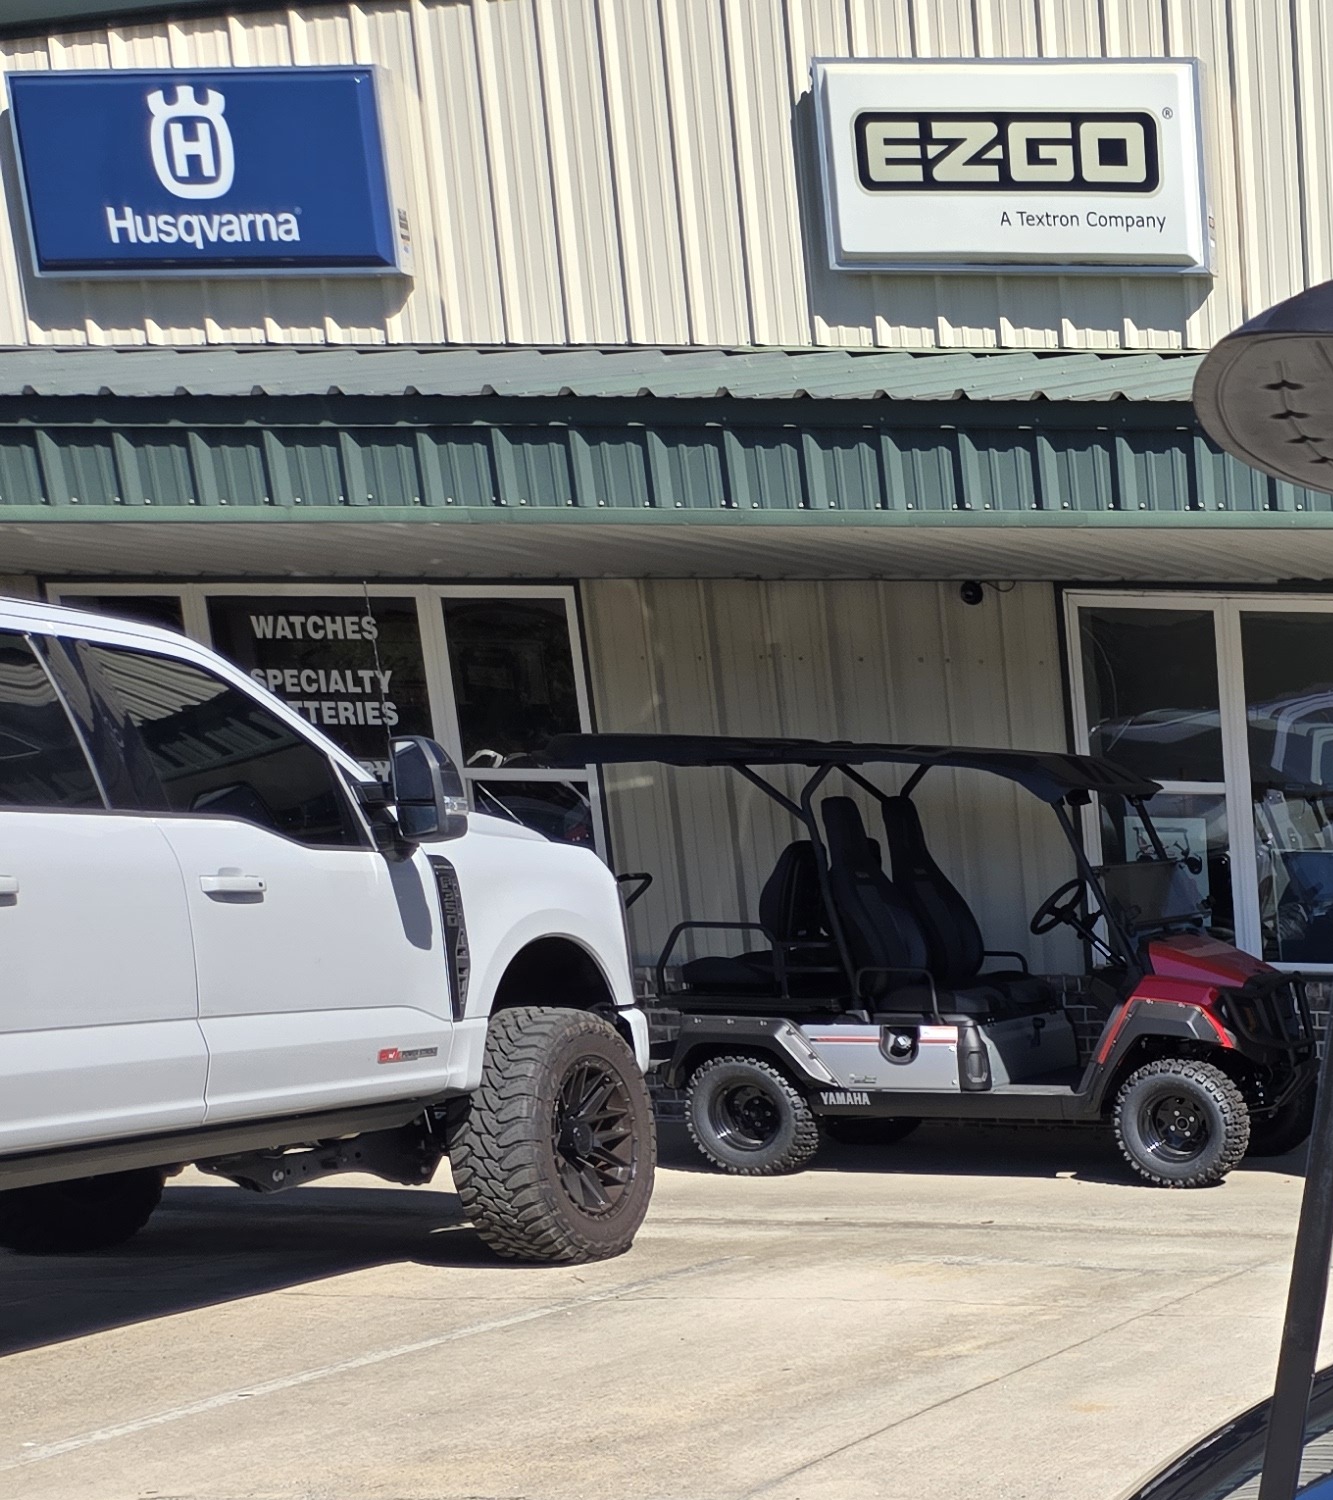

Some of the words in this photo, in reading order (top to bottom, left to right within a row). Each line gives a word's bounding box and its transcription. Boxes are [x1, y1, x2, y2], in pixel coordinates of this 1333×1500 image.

[864, 121, 1147, 182] EZGO
[105, 206, 301, 250] Husqvarna
[1000, 211, 1012, 227] A
[1016, 211, 1080, 227] Textron
[1086, 211, 1166, 233] Company
[250, 615, 379, 640] WATCHES
[250, 668, 392, 693] SPECIALTY
[820, 1092, 871, 1105] YAMAHA
